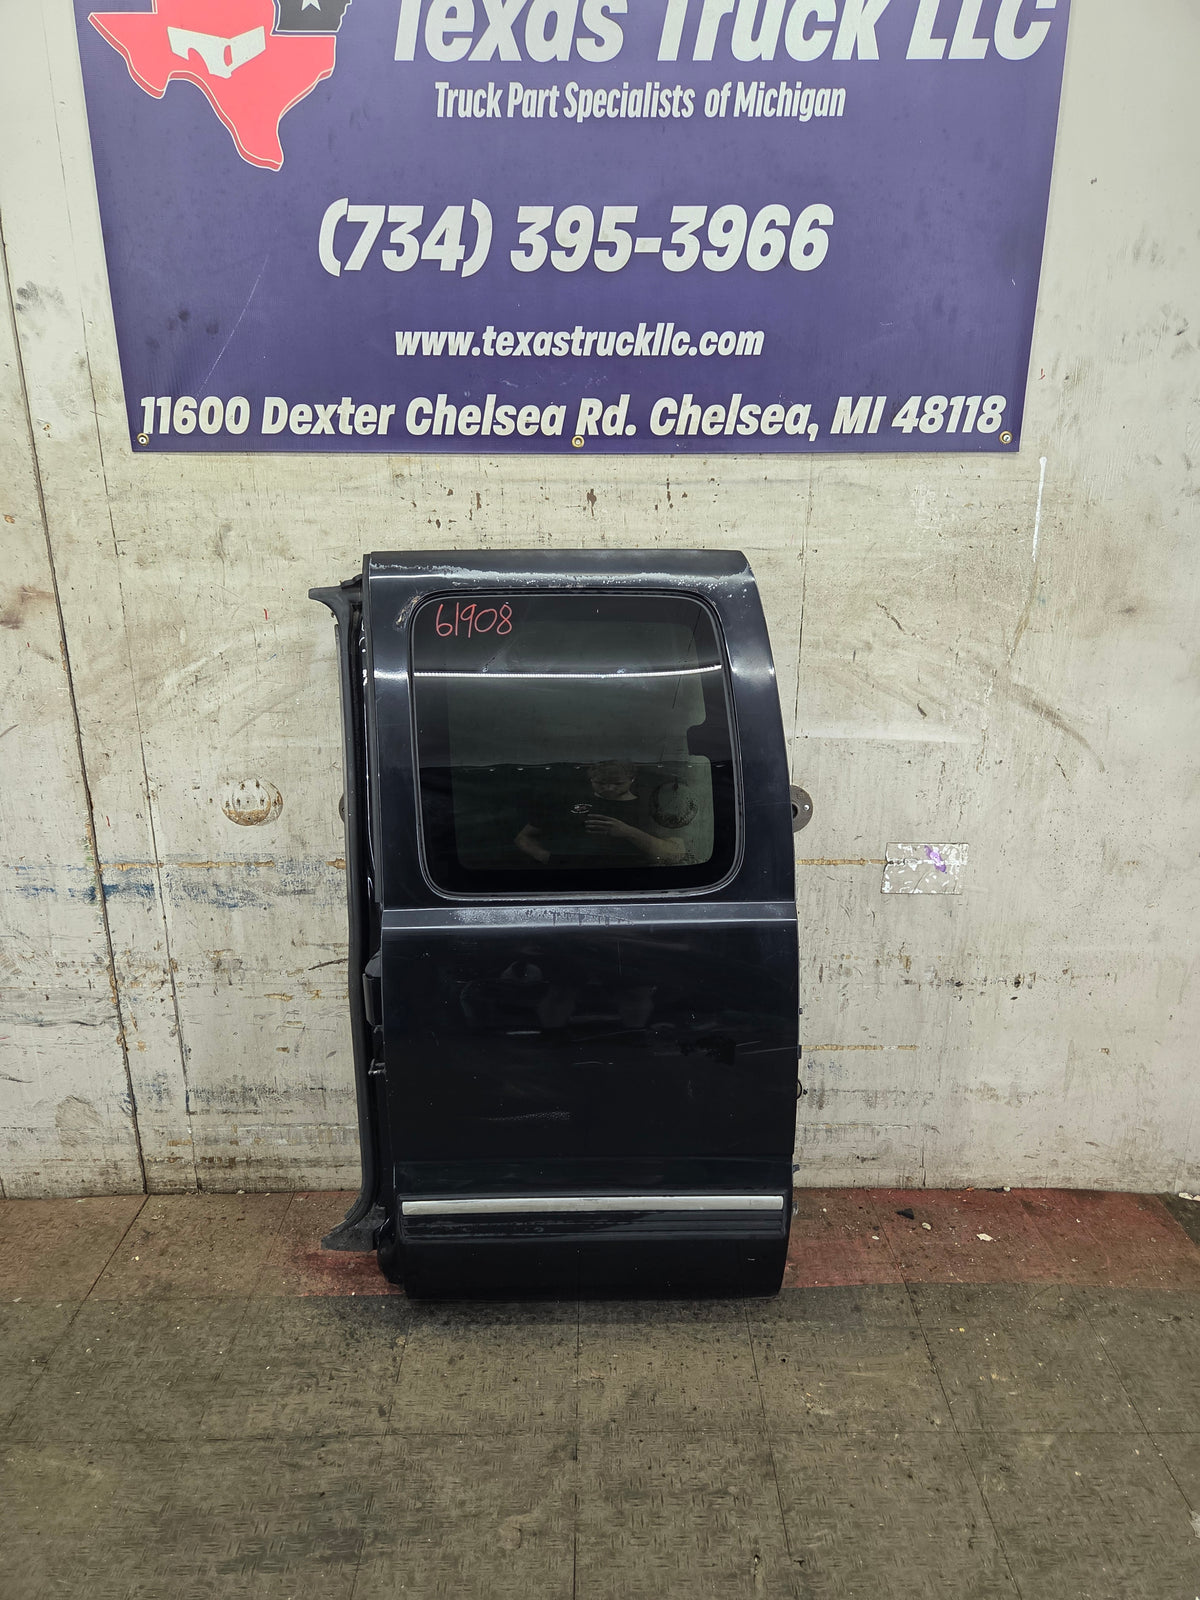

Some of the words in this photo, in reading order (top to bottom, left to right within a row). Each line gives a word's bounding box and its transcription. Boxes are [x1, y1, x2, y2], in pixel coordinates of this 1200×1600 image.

[393, 0, 629, 63] Texas
[656, 0, 892, 62] Truck
[905, 0, 1057, 61] LLC
[434, 81, 504, 118] Truck
[506, 81, 561, 118] Part
[562, 80, 696, 123] Specialists
[703, 81, 733, 118] of
[732, 80, 847, 122] Michigan
[318, 197, 493, 278] (734)
[510, 204, 835, 272] 395-3966
[394, 322, 765, 357] www.texastruckllc.com
[140, 396, 251, 435] 11600
[260, 396, 396, 436] Dexter
[405, 393, 567, 436] Chelsea
[574, 393, 637, 436] Rd.
[649, 393, 819, 442] Chelsea,
[829, 395, 888, 435] MI
[890, 394, 1007, 434] 48118
[435, 602, 513, 638] 61908
